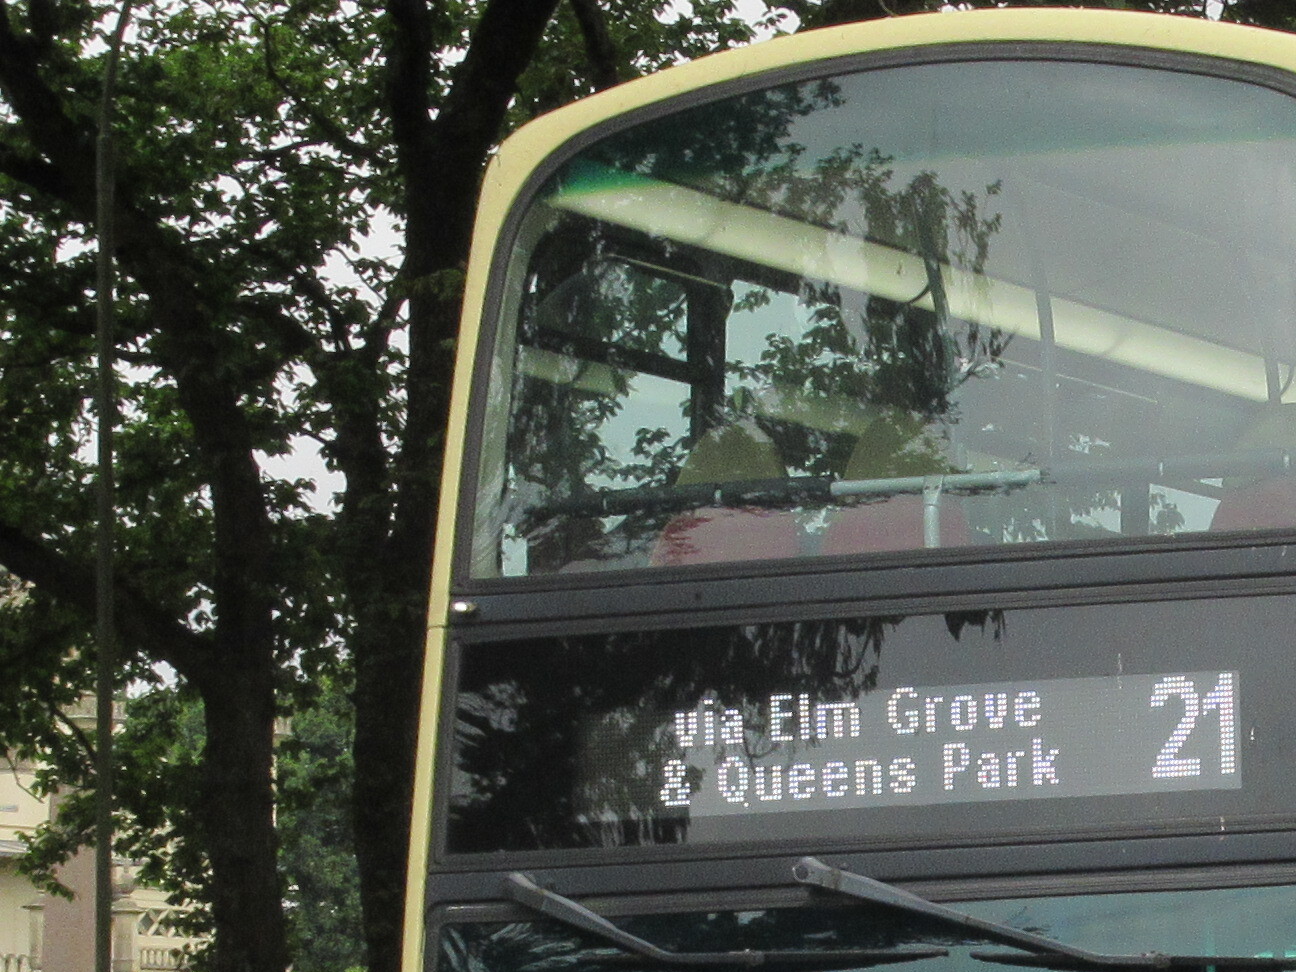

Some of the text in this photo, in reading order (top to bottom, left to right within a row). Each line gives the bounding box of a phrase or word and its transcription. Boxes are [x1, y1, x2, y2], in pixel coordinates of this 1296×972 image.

[674, 686, 1042, 748] via Elm Grove
[1149, 671, 1235, 780] 21
[659, 737, 1060, 809] & Queens Park
